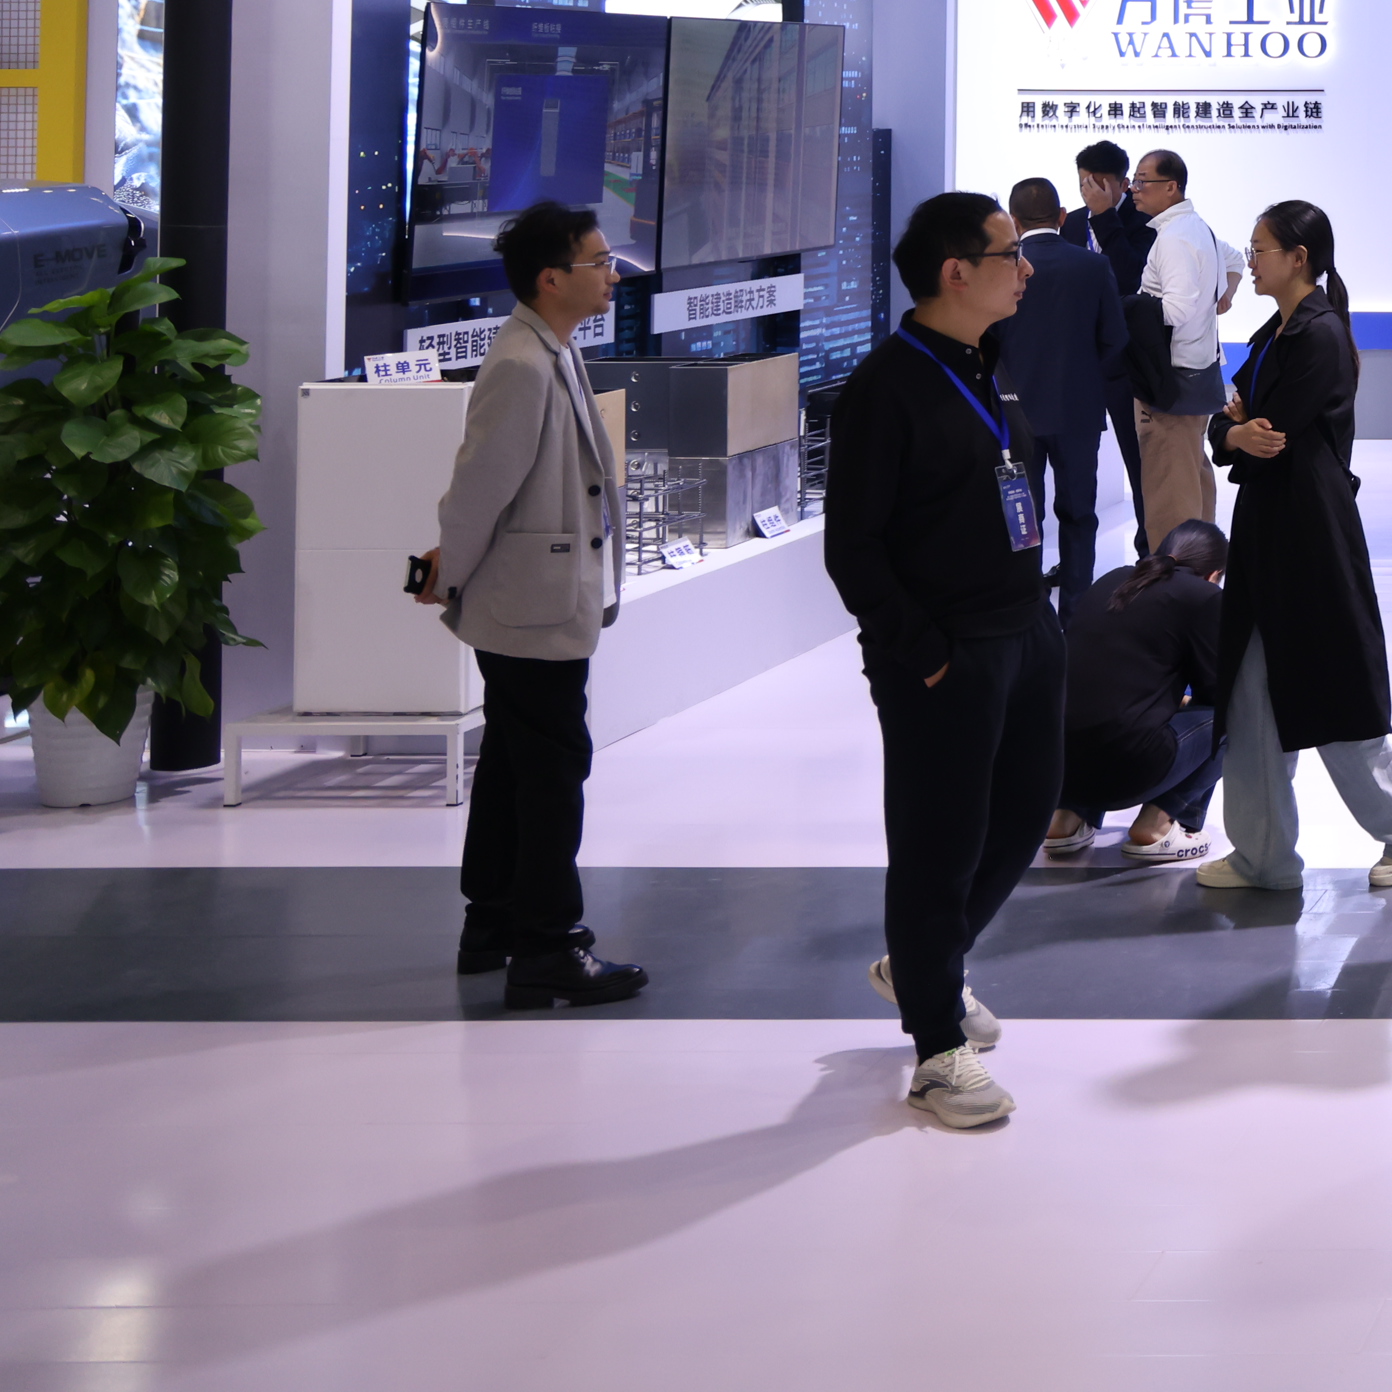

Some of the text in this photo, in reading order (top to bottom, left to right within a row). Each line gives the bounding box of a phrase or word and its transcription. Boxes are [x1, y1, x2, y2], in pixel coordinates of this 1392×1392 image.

[1111, 31, 1328, 59] WANHOO
[1019, 101, 1323, 119] 用数字化串起智能建造全产业链
[1092, 123, 1116, 131] Supply
[1146, 123, 1181, 131] Intelligent
[1277, 123, 1323, 131] Digitalization
[686, 284, 777, 322] 智能建造解决方案
[373, 358, 433, 378] 柱单元
